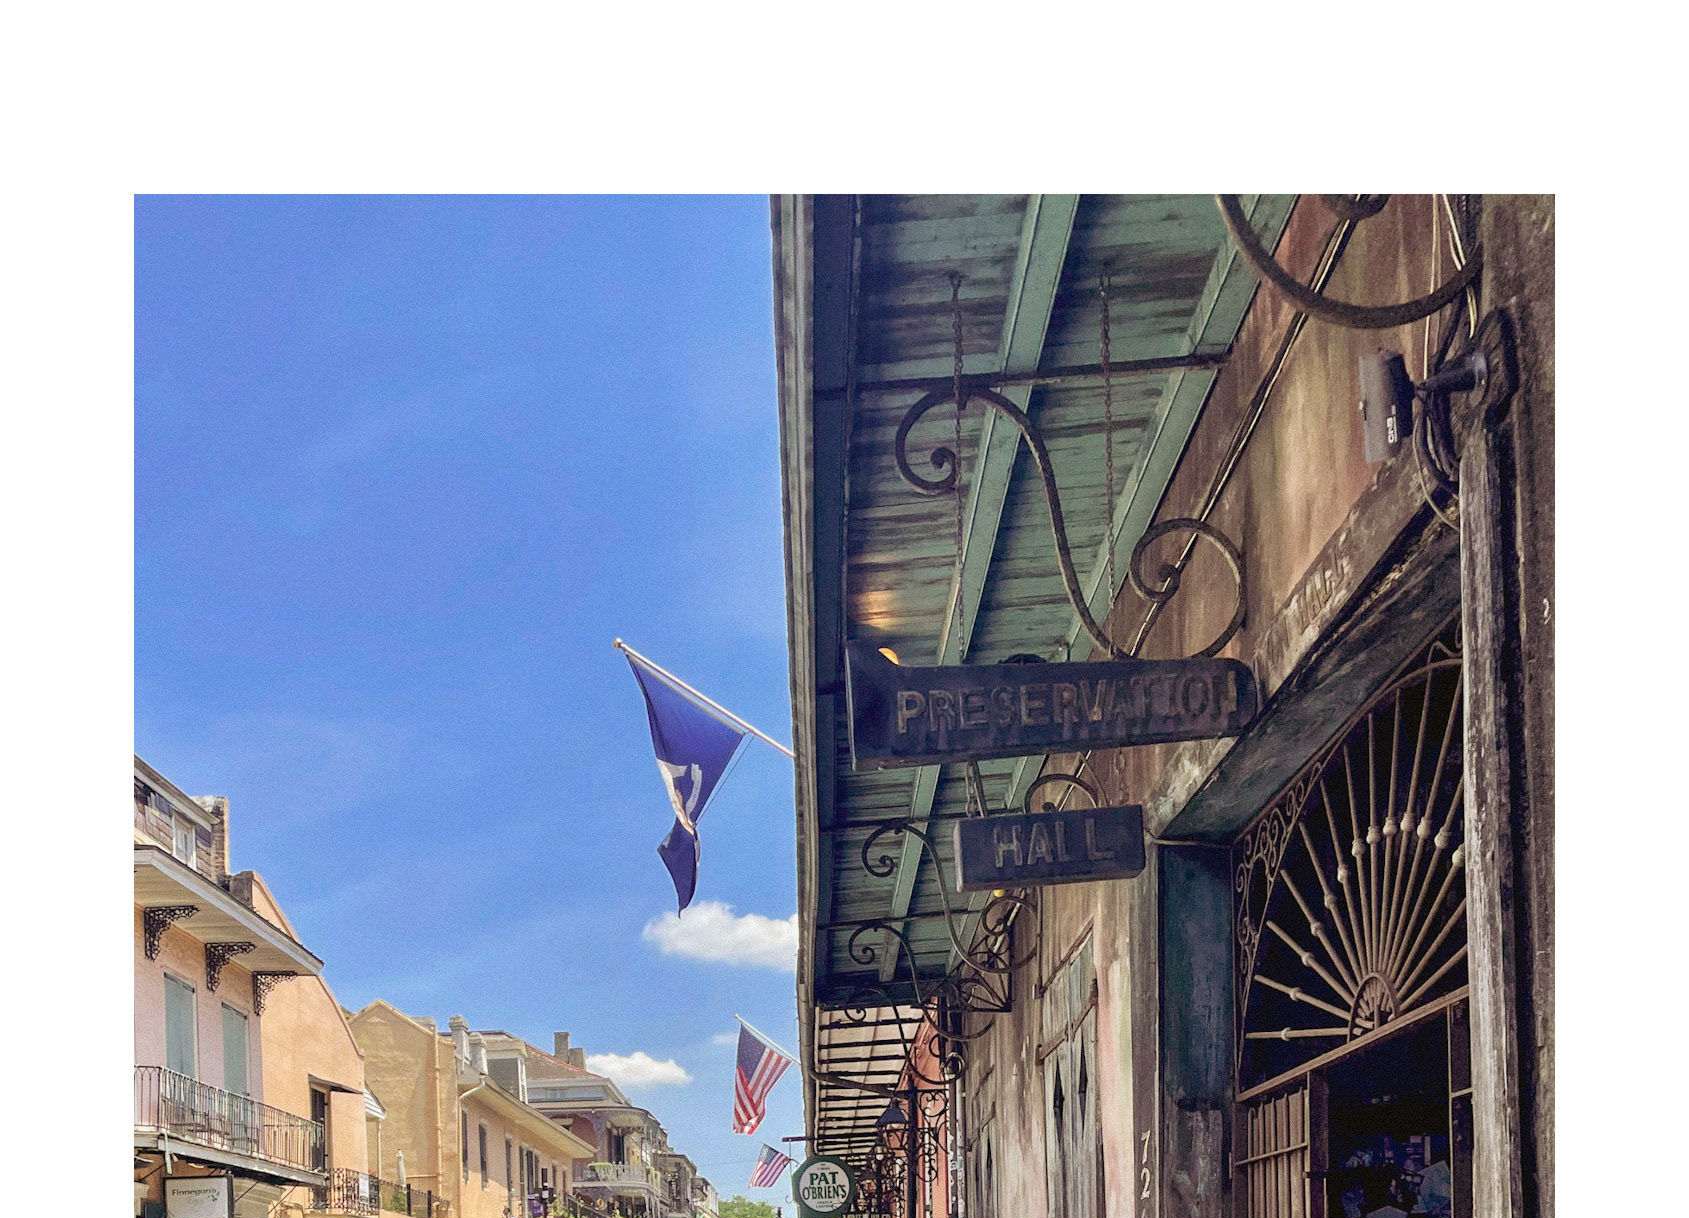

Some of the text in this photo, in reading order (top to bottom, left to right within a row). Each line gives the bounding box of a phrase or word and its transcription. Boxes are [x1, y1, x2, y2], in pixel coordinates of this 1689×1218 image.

[897, 671, 1237, 733] PRESERVATION
[994, 817, 1114, 868] HALL
[802, 1184, 847, 1200] O'BRIEN'S
[809, 1172, 839, 1186] PAT
